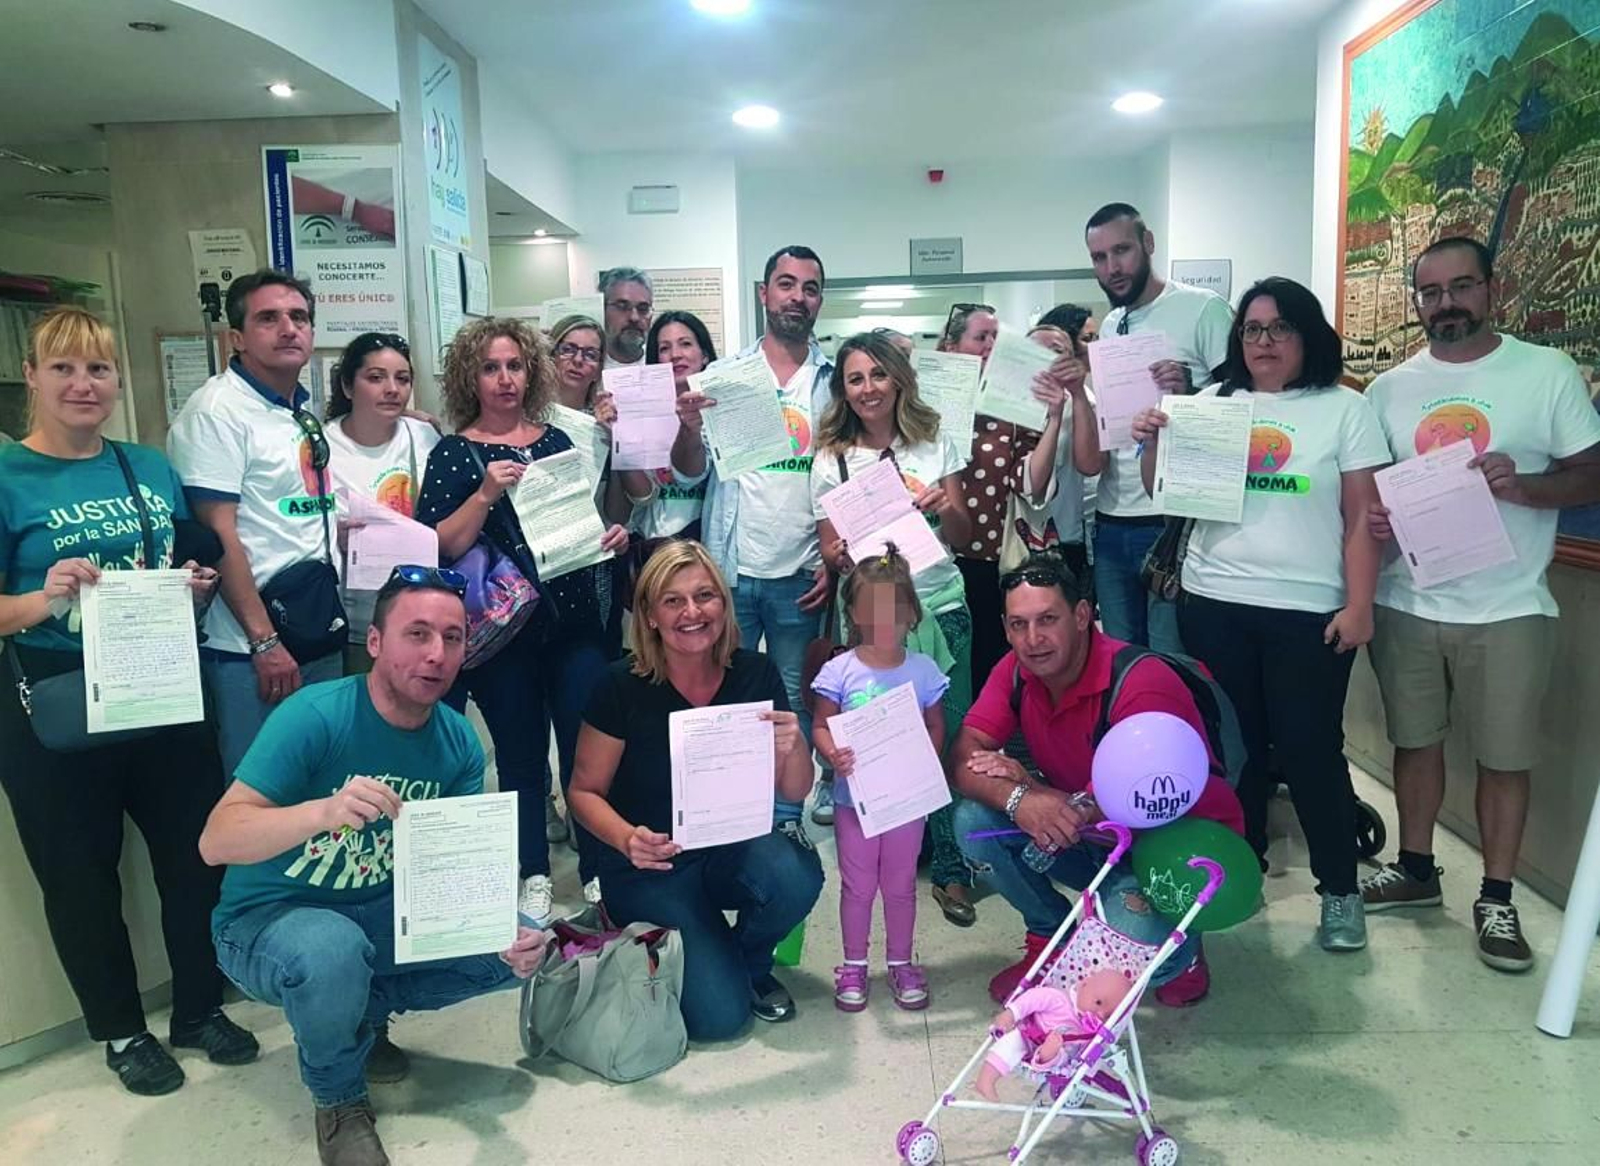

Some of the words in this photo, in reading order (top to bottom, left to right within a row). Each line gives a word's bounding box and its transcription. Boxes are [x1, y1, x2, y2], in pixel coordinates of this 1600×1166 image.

[316, 262, 387, 271] NECESITAMOS
[1181, 275, 1222, 286] Seguridad
[328, 293, 356, 303] ERES
[53, 533, 82, 552] por
[84, 528, 101, 541] la
[1134, 789, 1191, 813] happy
